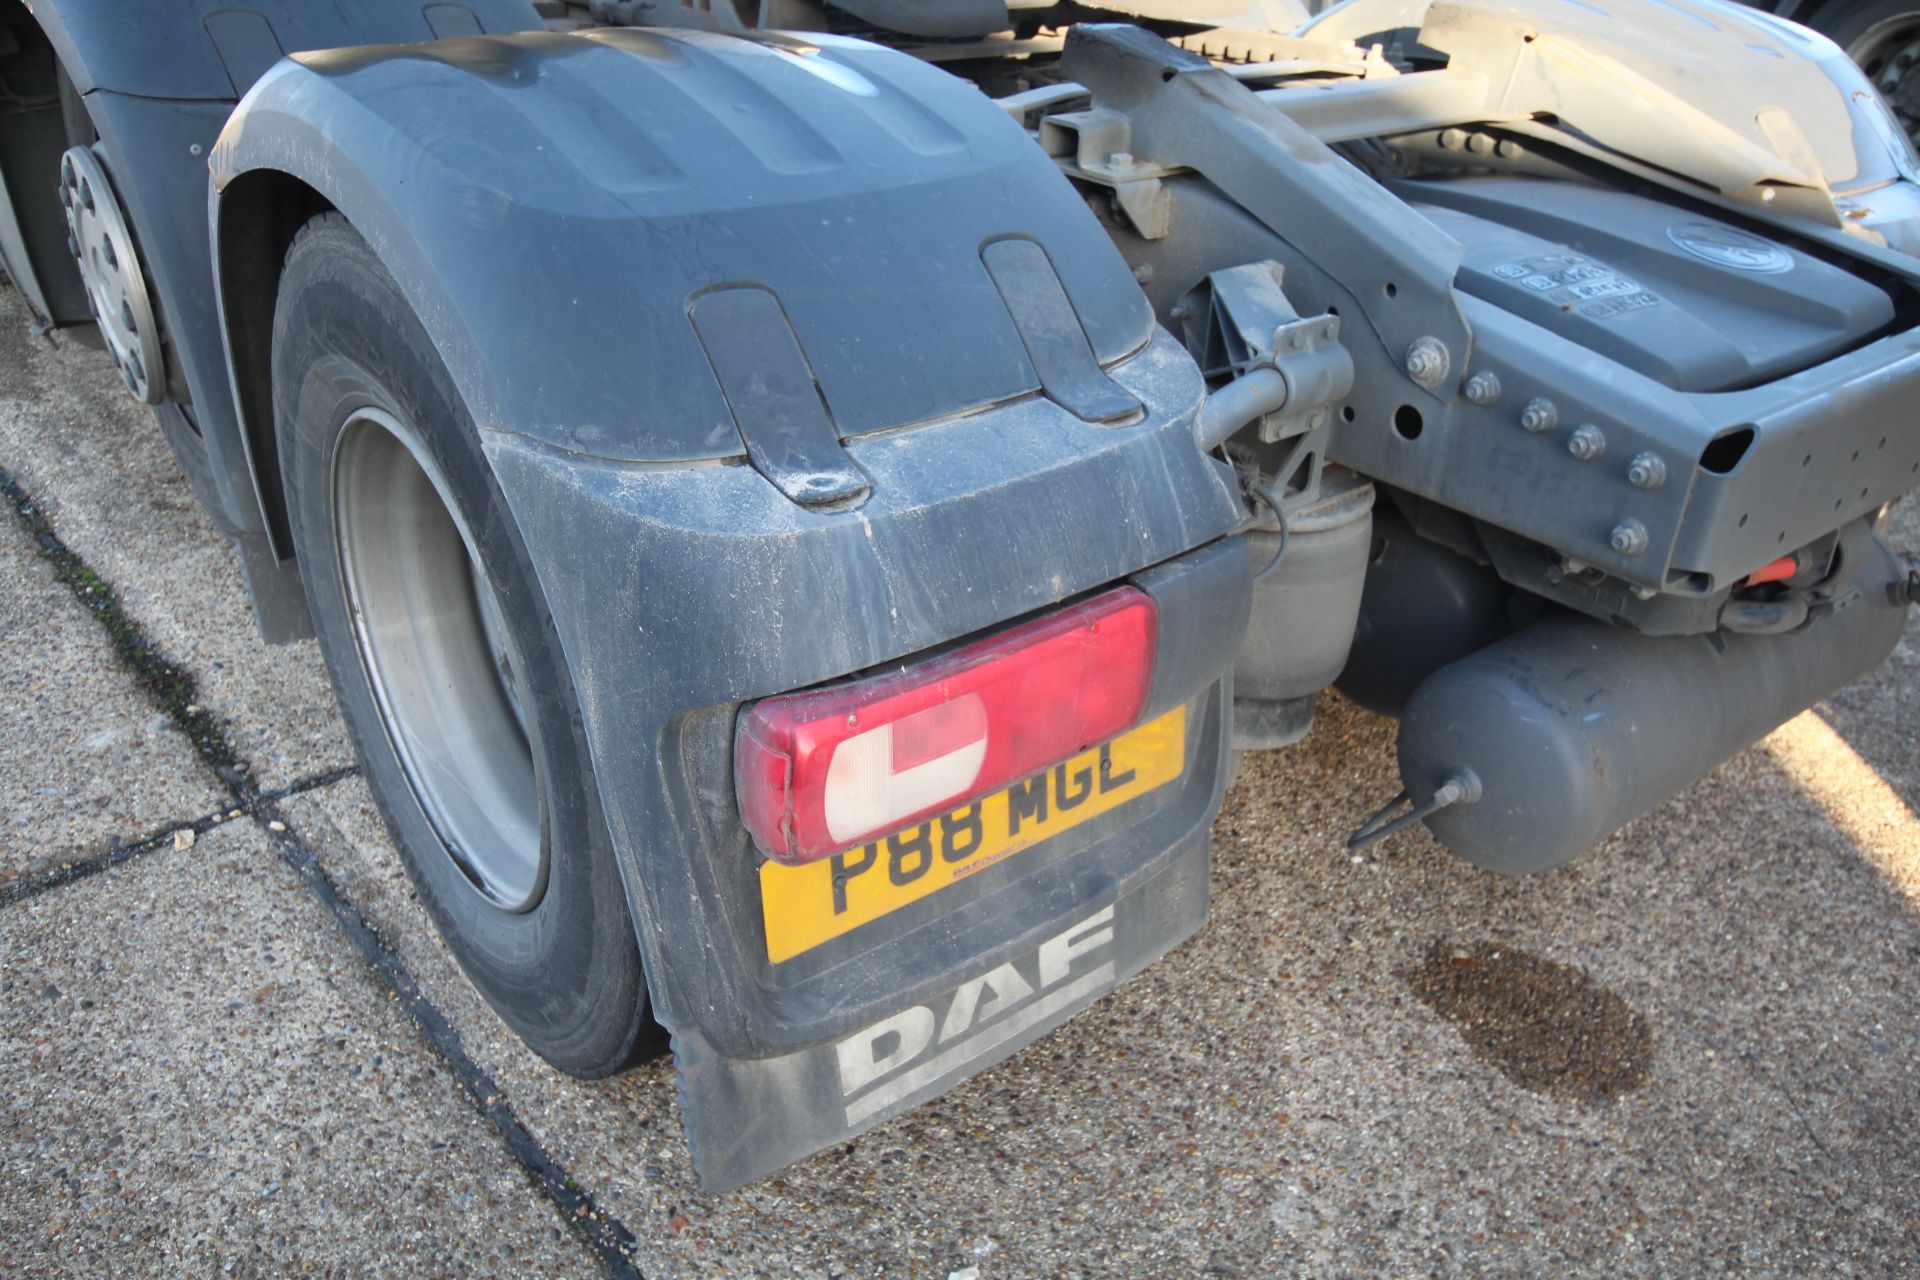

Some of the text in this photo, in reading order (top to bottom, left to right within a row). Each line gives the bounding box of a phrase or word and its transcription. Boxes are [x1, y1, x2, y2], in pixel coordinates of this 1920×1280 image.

[830, 744, 1136, 916] P88 MGL
[836, 904, 1114, 1097] DAF
